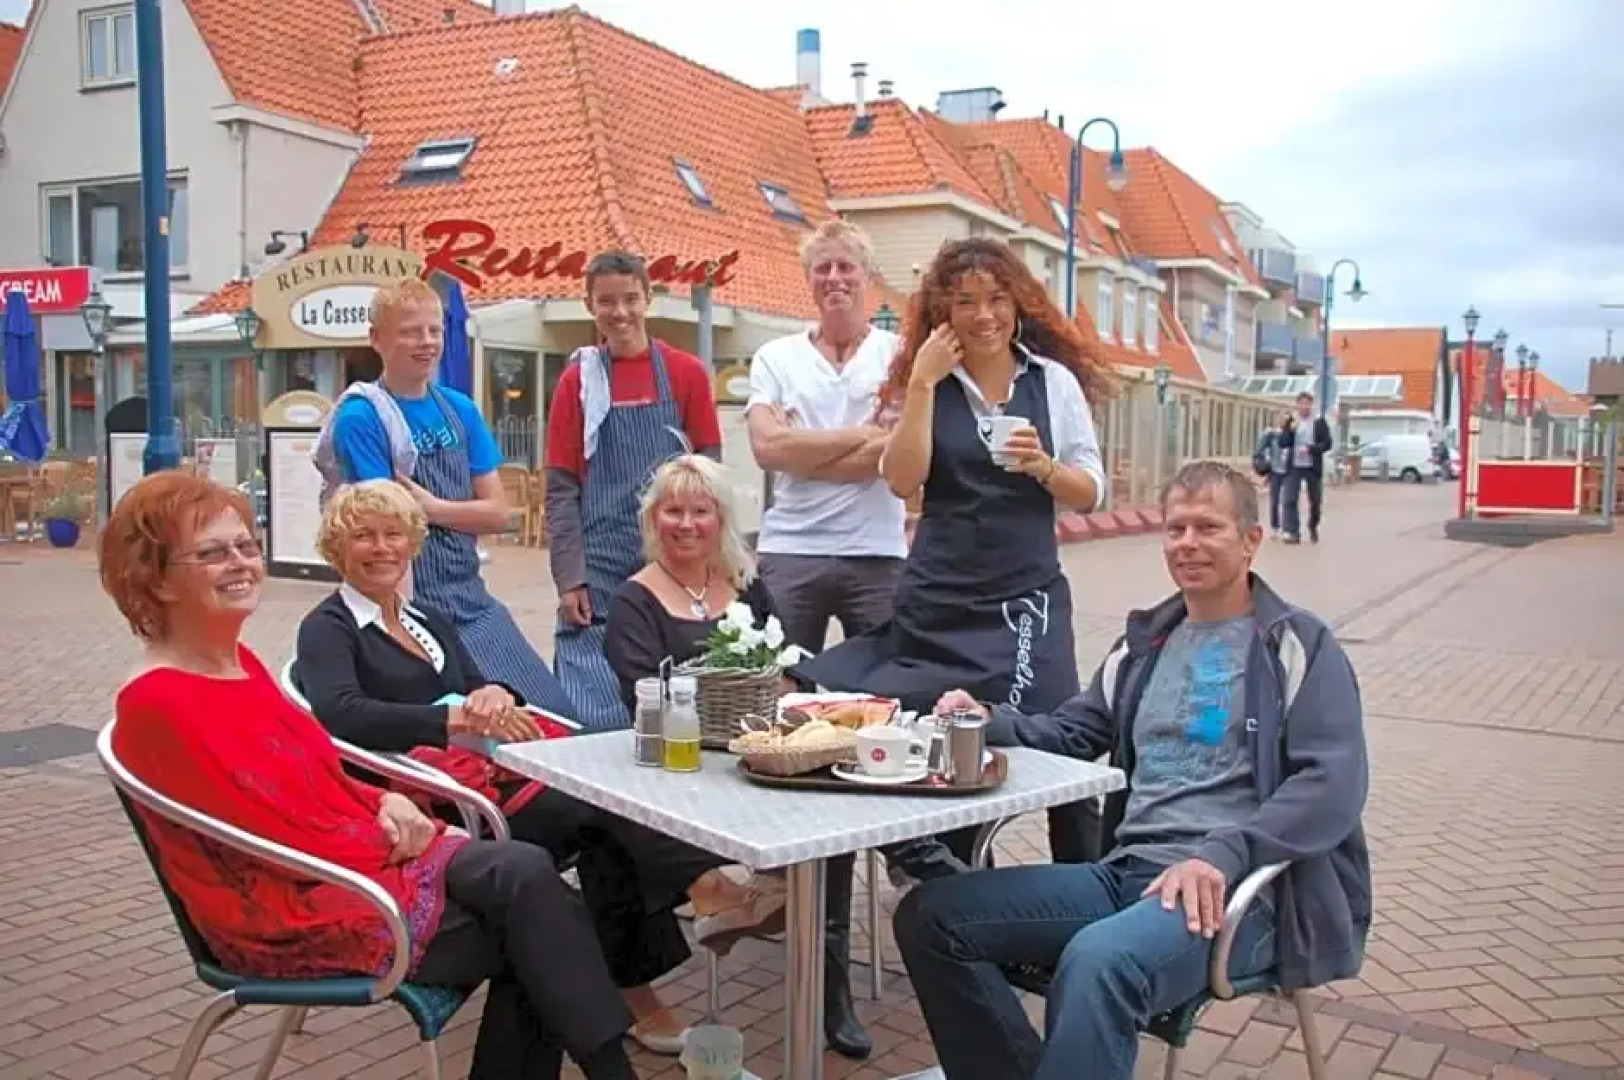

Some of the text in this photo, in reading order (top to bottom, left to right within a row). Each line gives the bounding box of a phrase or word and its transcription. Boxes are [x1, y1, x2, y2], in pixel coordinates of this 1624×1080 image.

[422, 219, 739, 288] Restaant
[276, 255, 422, 291] RESTAURANT
[302, 301, 318, 325] La
